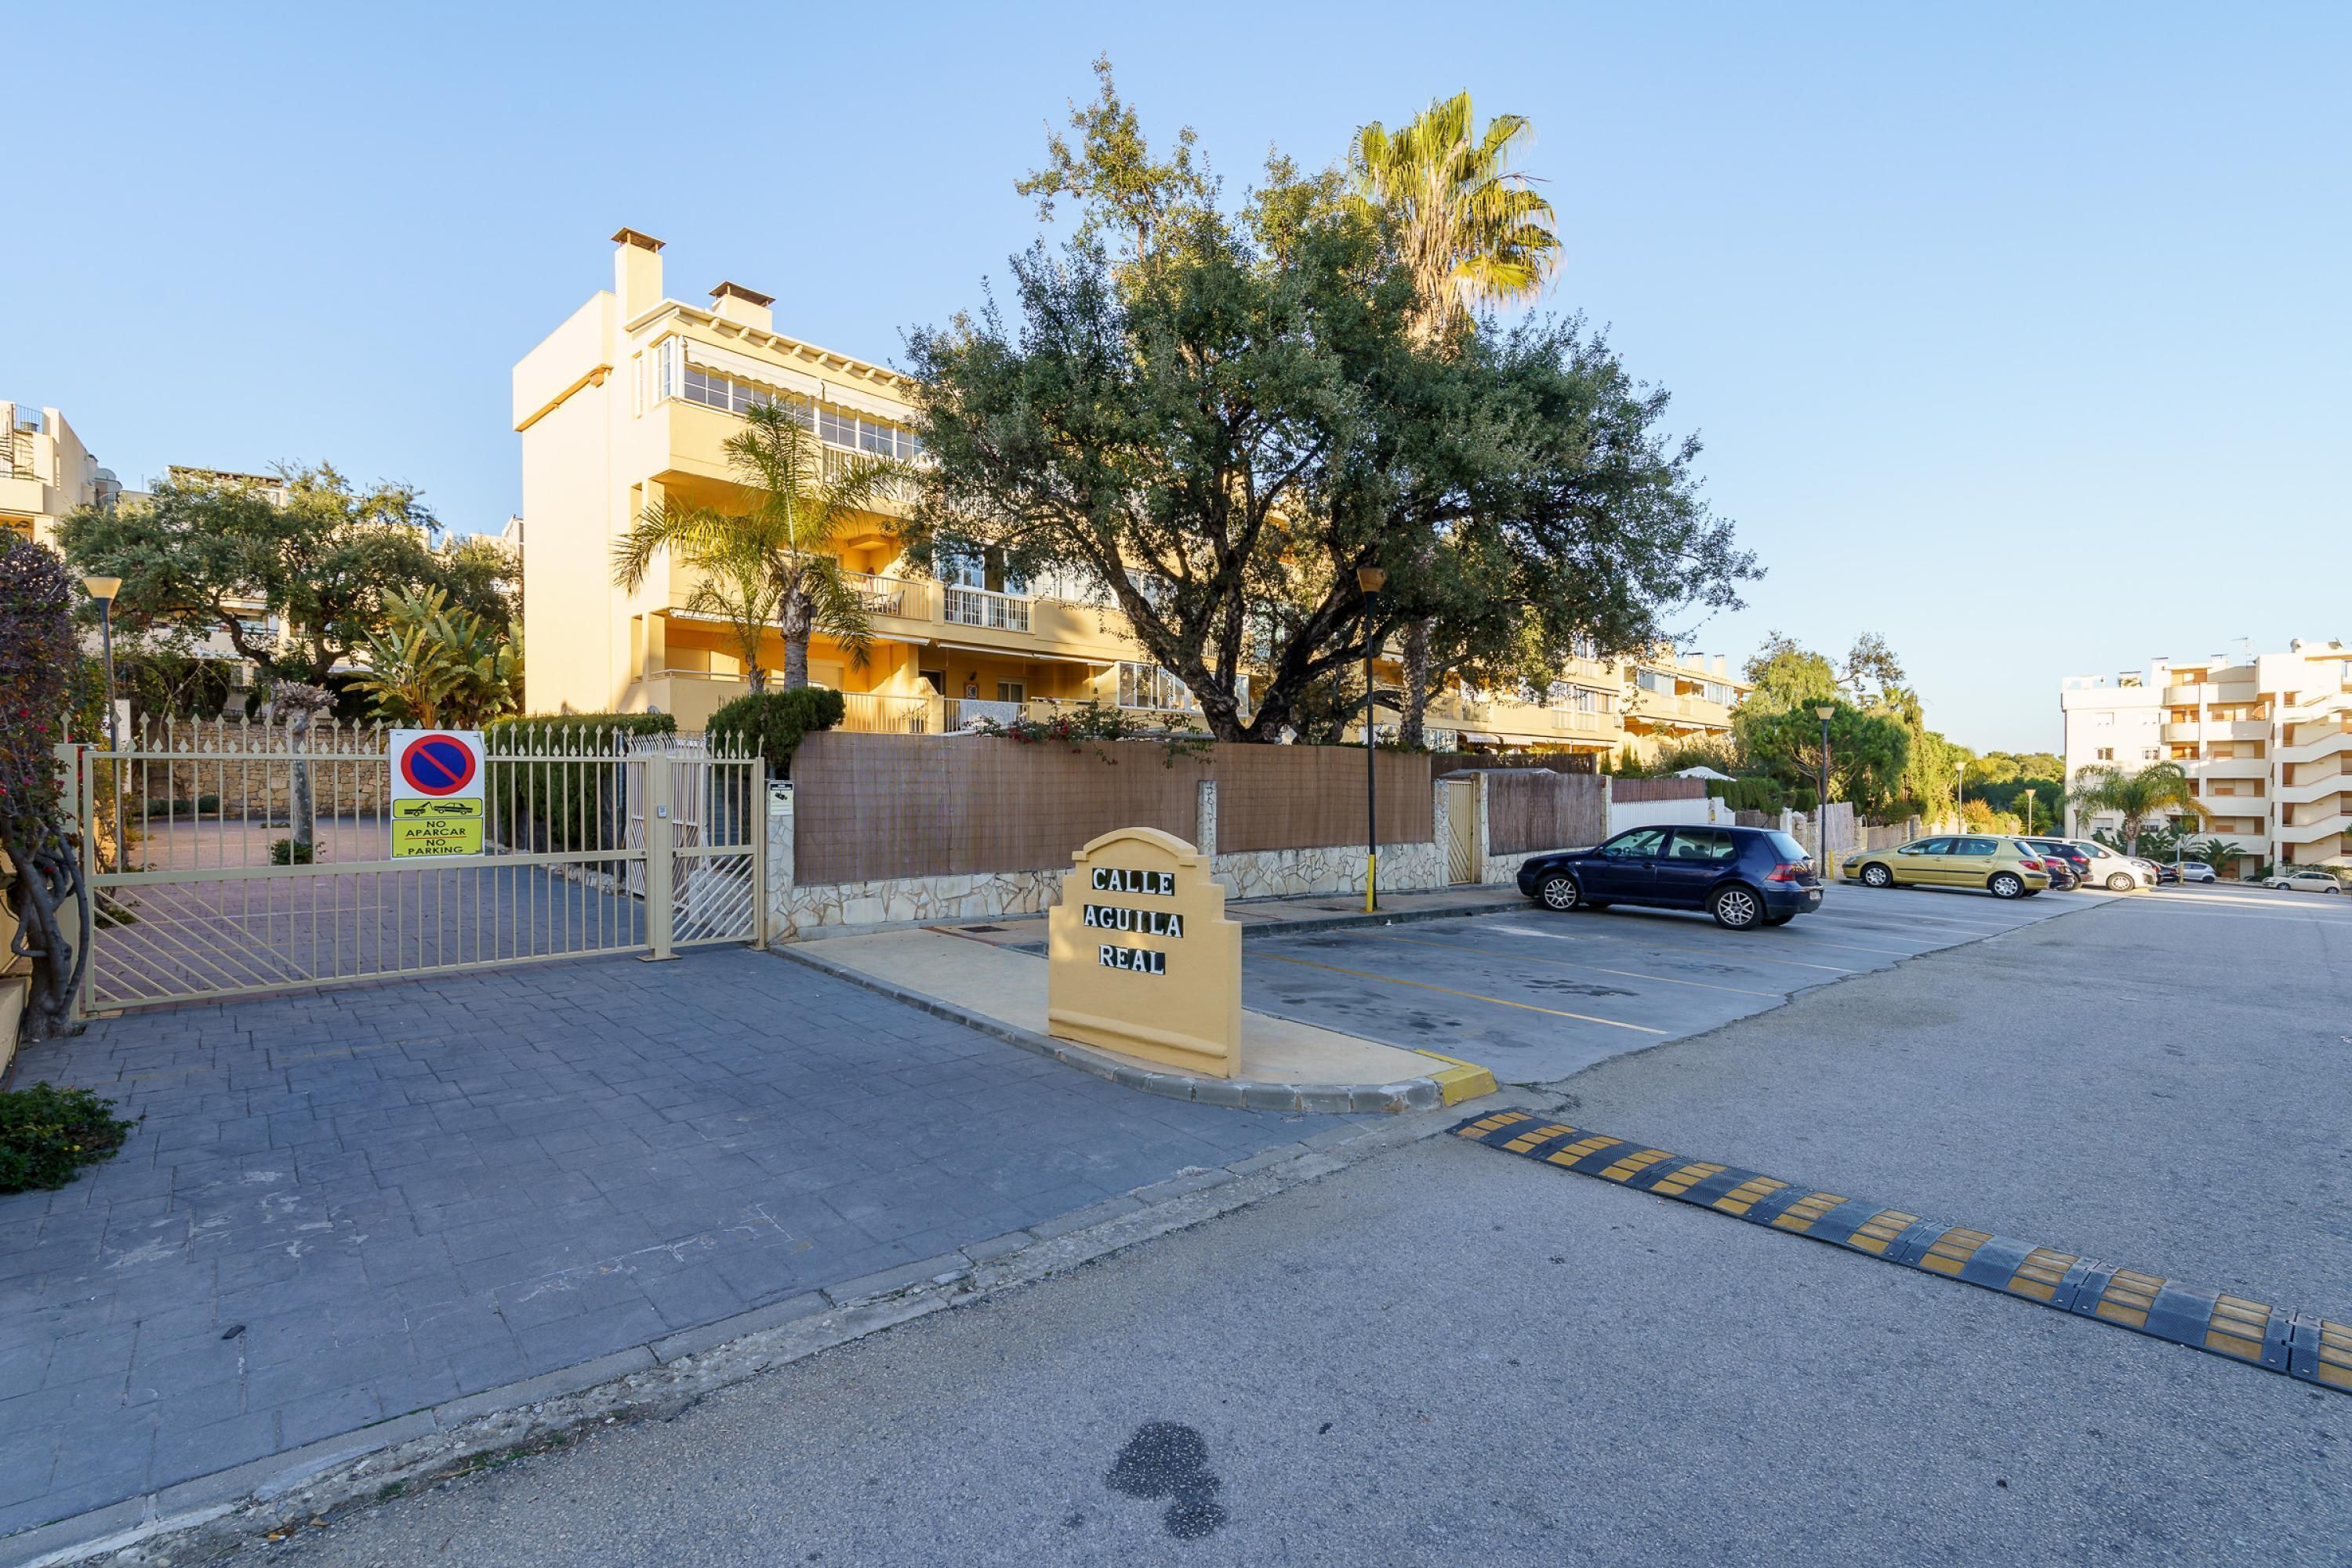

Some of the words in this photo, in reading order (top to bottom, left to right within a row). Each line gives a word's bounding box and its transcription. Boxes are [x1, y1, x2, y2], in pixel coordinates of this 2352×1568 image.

[405, 828, 466, 837] APARCAR
[408, 846, 463, 855] PARKING
[1093, 868, 1173, 895] CALLE
[1084, 905, 1181, 938] AGUILA
[1098, 944, 1164, 975] REAL
